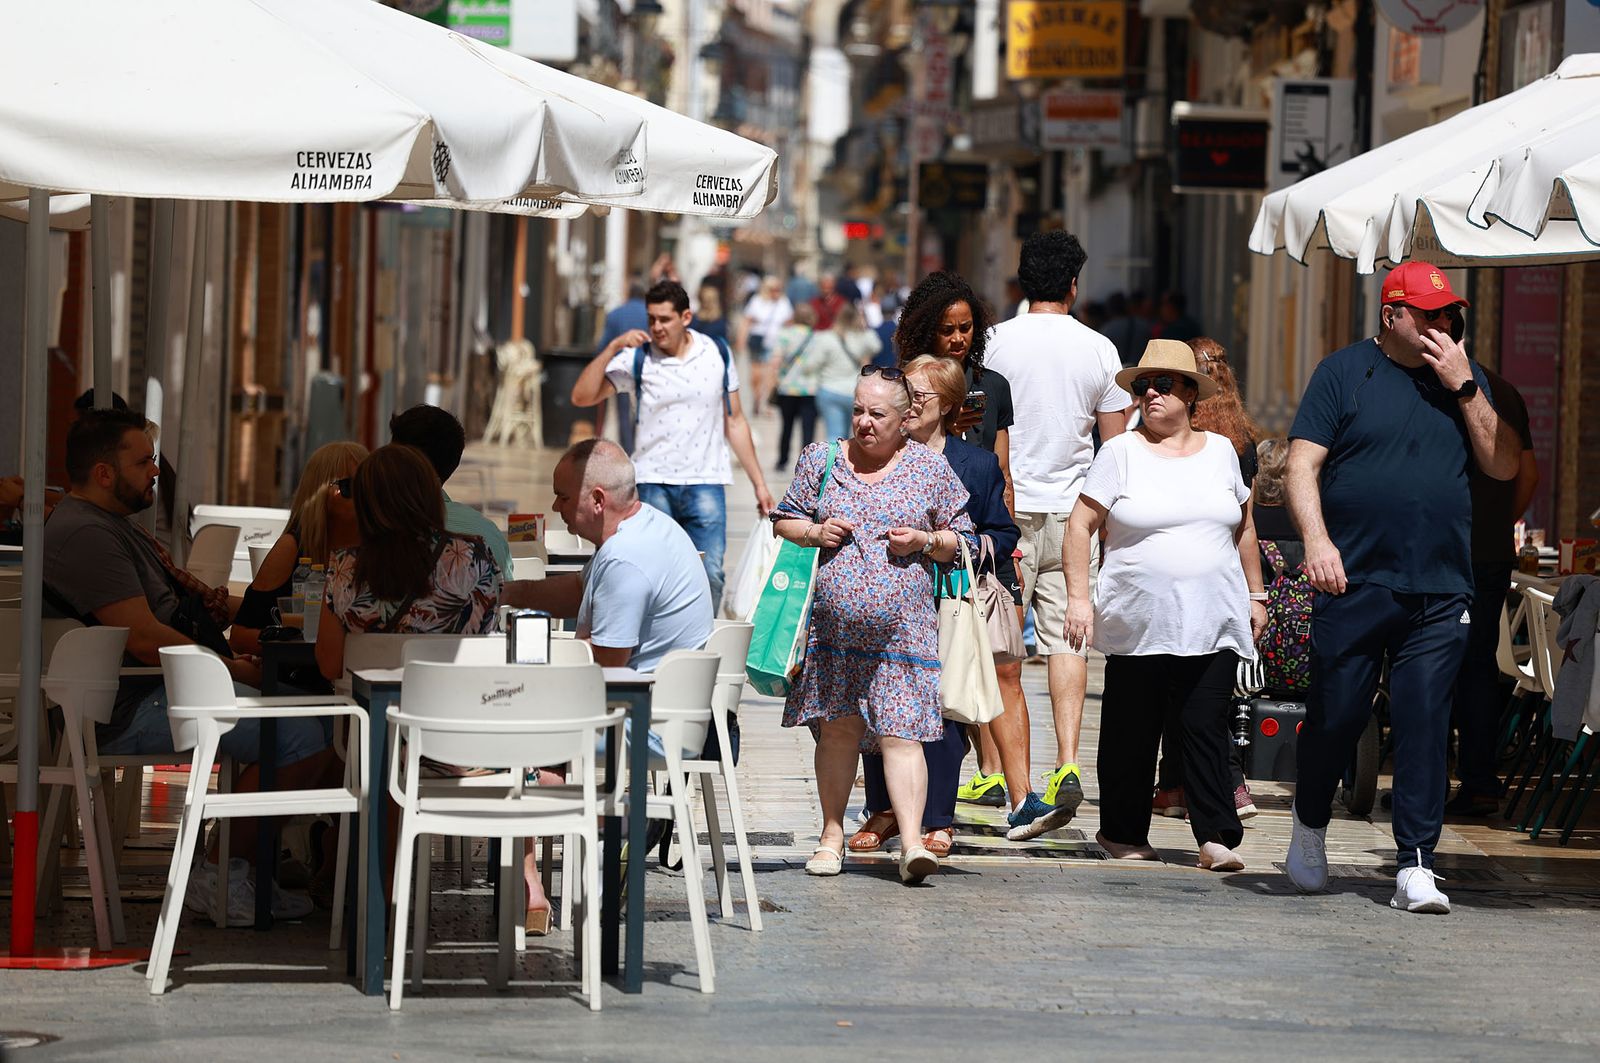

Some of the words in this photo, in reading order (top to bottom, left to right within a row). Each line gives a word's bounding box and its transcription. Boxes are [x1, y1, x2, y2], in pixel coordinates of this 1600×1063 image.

[296, 151, 372, 170] CERVEZAS
[290, 172, 372, 190] ALHAMBRA
[696, 174, 743, 191] CERVEZAS
